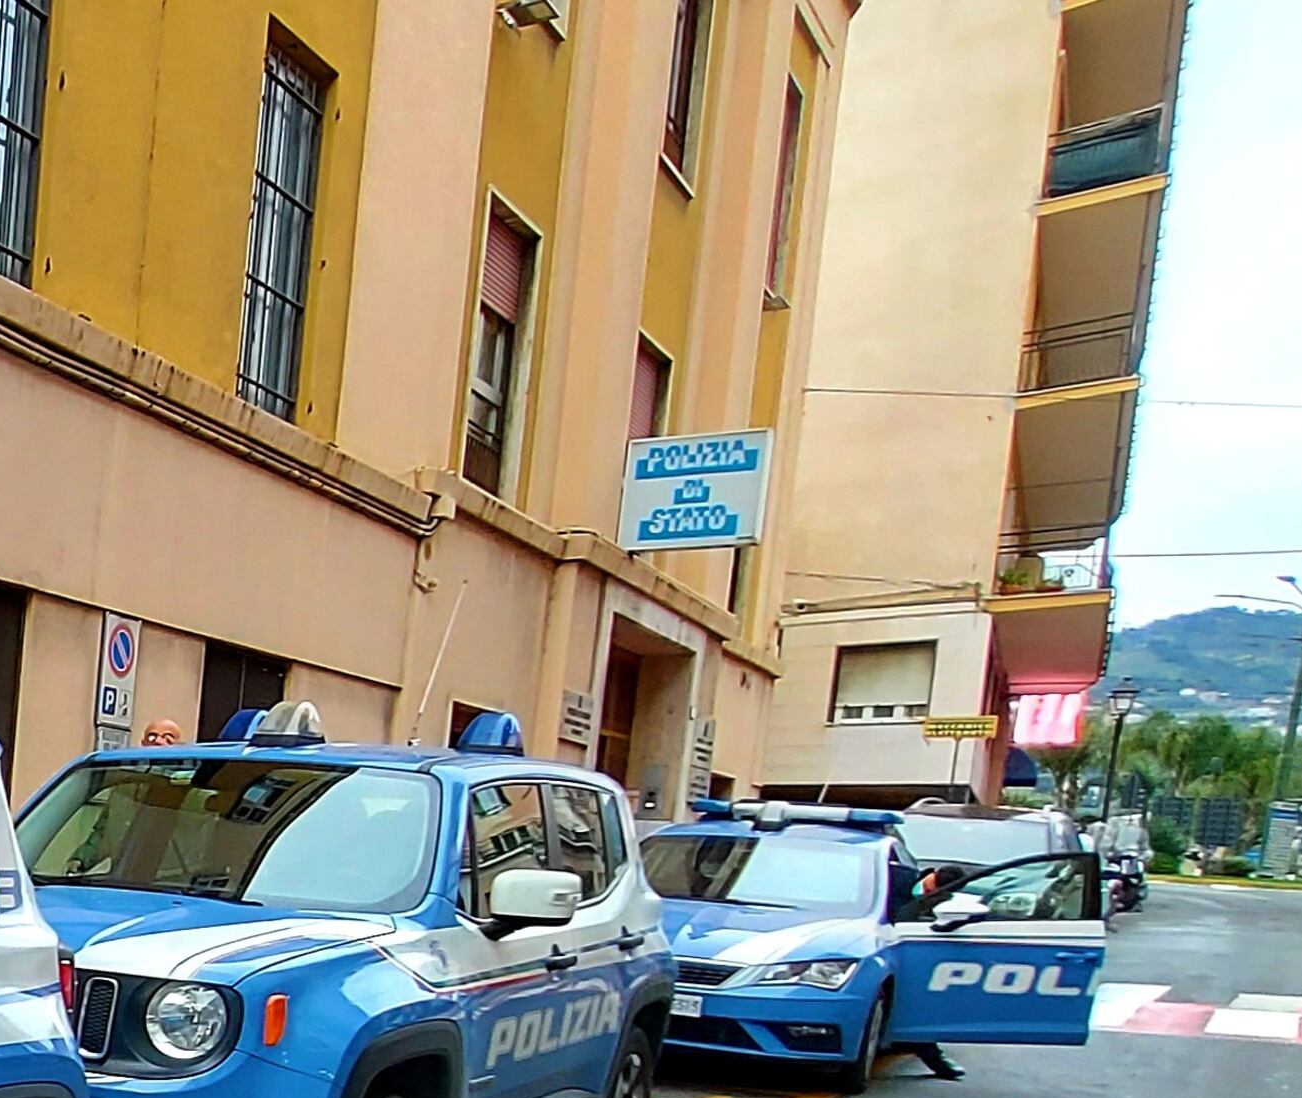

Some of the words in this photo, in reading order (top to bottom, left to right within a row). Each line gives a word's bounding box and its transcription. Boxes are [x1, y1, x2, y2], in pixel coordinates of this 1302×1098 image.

[647, 440, 745, 472] POLIZIA
[682, 479, 703, 498] DI
[648, 505, 725, 533] STATO
[105, 690, 114, 710] P
[486, 991, 620, 1069] POLIZIA
